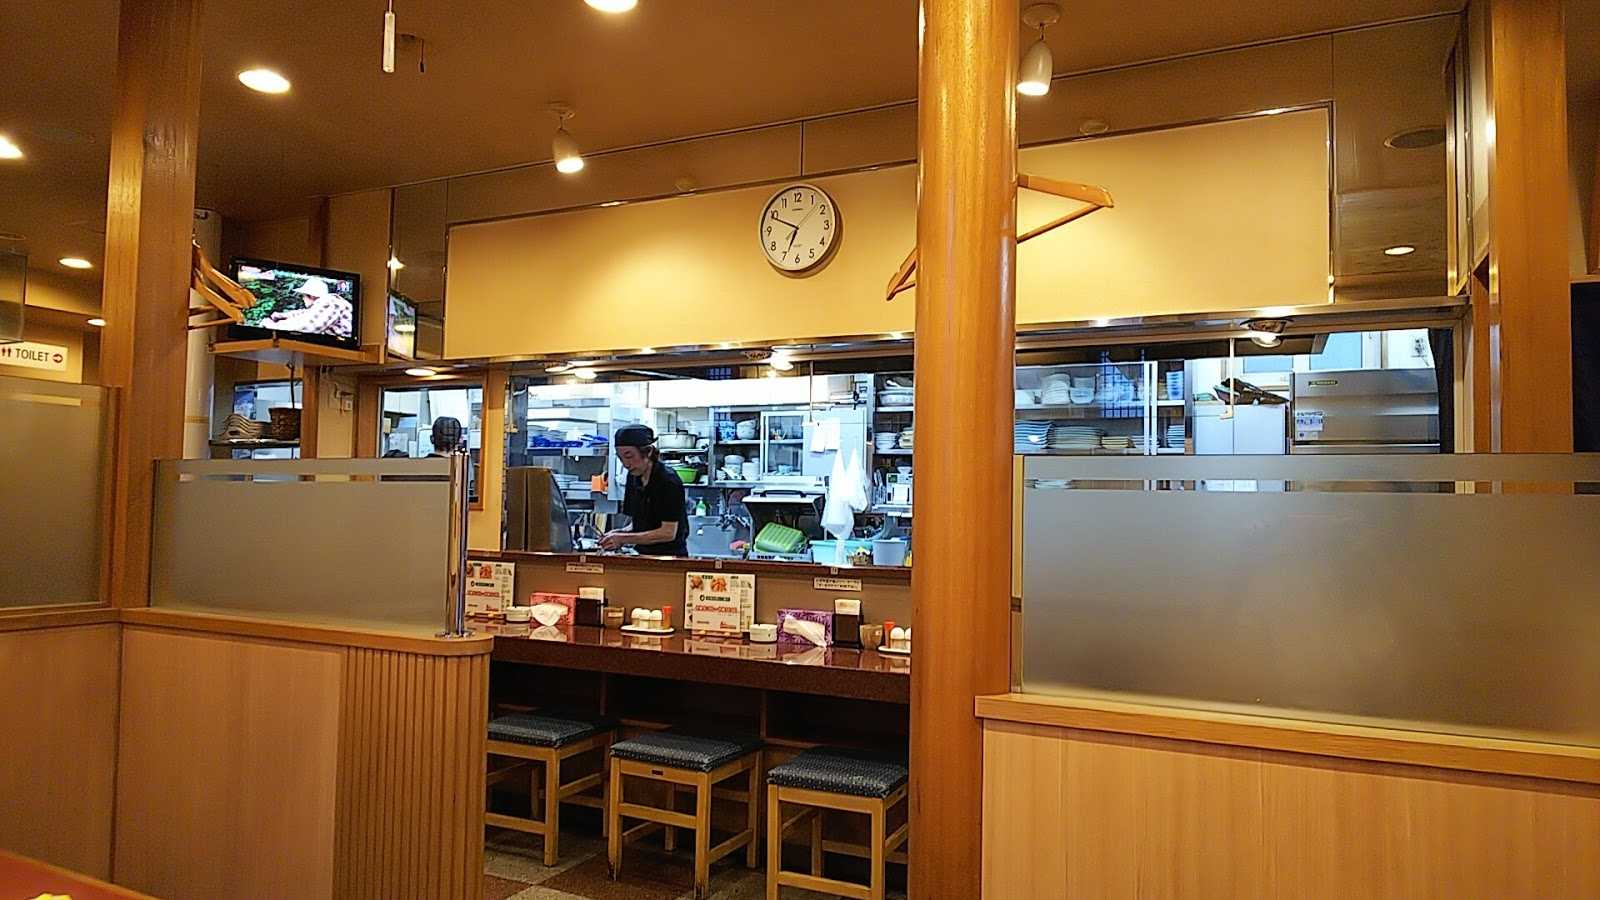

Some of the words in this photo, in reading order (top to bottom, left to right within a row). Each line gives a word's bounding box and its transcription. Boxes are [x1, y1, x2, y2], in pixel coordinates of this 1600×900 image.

[794, 192, 802, 202] 12
[810, 195, 814, 205] 1
[781, 198, 788, 208] 11
[770, 210, 779, 219] 10
[820, 204, 826, 215] 2
[824, 220, 830, 230] 3
[766, 226, 772, 236] 9
[770, 241, 776, 251] 8
[820, 236, 825, 246] 4
[782, 251, 788, 260] 7
[809, 248, 814, 258] 5
[794, 254, 800, 264] 6
[16, 348, 49, 362] TOILET
